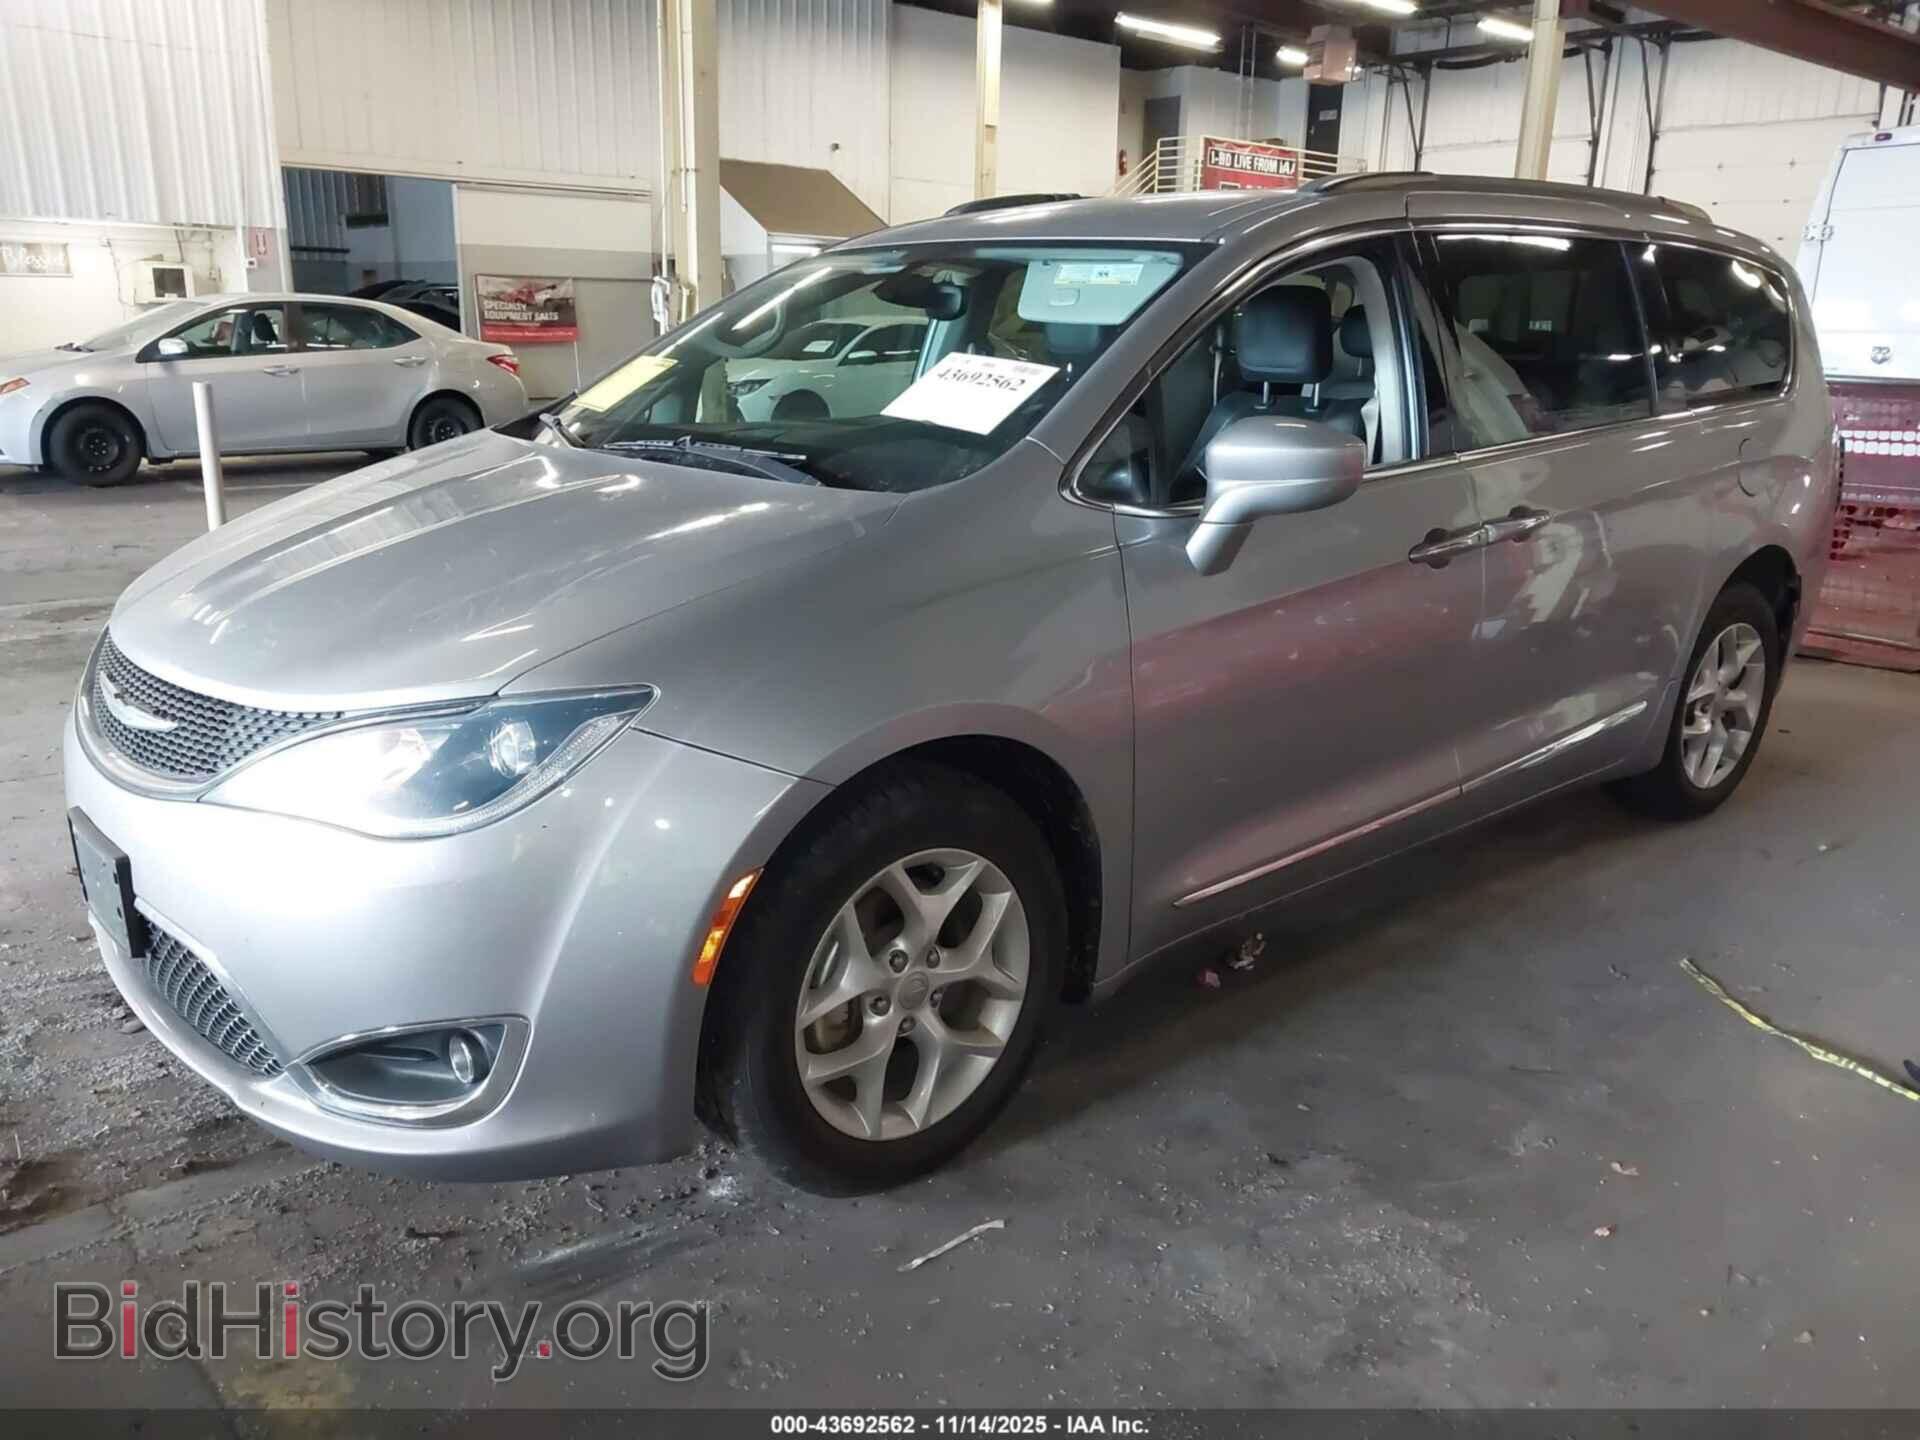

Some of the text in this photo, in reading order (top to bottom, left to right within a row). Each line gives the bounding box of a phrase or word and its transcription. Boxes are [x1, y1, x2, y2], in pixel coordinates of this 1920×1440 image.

[1233, 153, 1253, 170] LIVE
[1253, 156, 1278, 174] FROM
[483, 300, 527, 311] SPECIALTY
[484, 311, 559, 321] EQUIPMENT SALES
[936, 367, 1027, 392] 43692562
